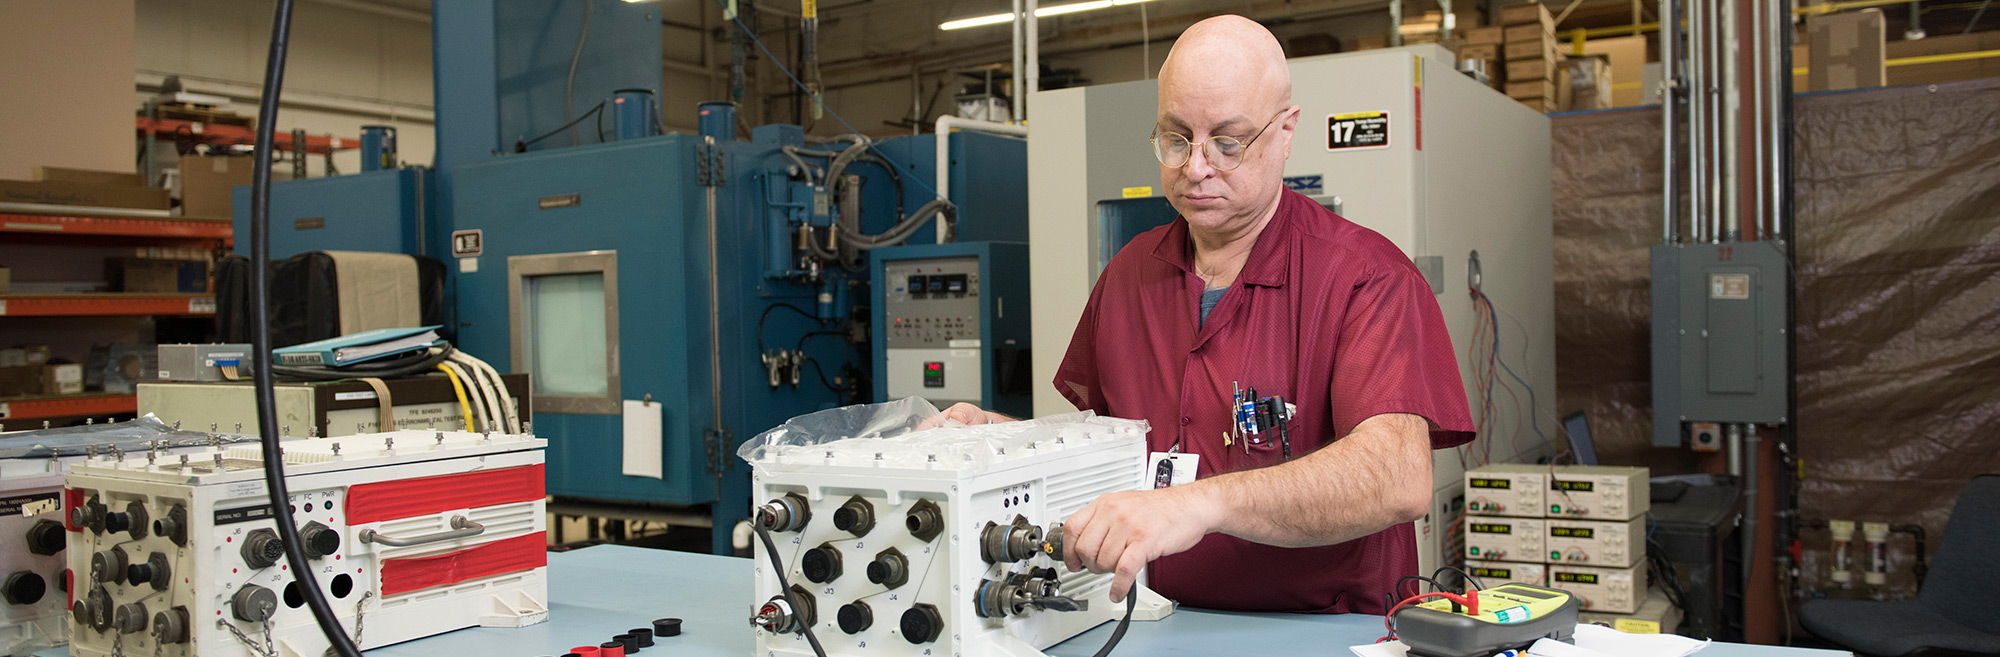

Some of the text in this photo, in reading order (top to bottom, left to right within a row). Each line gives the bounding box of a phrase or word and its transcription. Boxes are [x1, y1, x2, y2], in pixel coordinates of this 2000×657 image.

[1331, 121, 1355, 143] 17
[304, 493, 313, 501] FC
[856, 541, 864, 549] J3
[323, 565, 333, 574] J12
[271, 574, 282, 582] J10
[824, 587, 835, 595] J13
